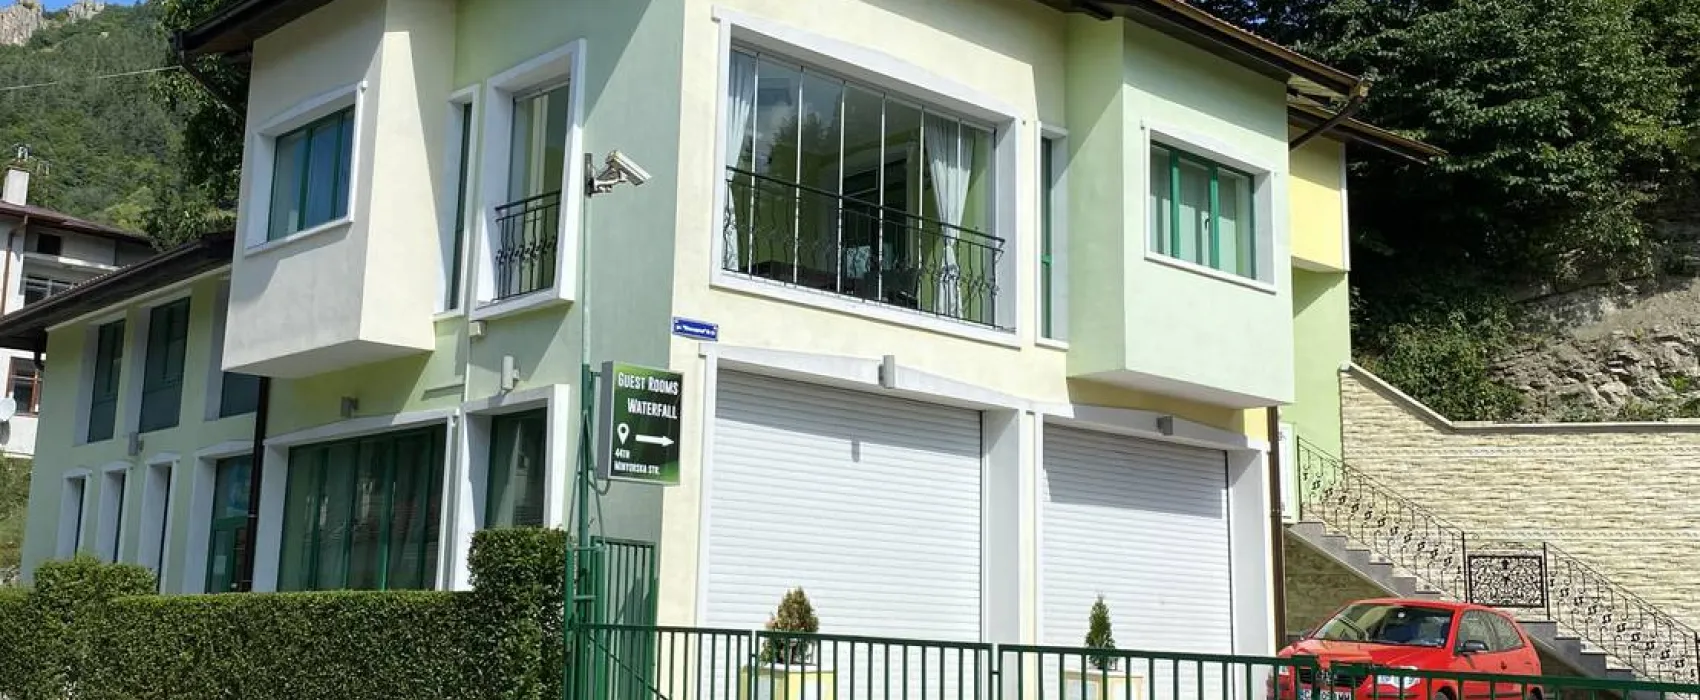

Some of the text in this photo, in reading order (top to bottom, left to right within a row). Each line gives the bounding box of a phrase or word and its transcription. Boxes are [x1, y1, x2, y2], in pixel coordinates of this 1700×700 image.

[618, 372, 678, 395] GUEST ROOMS
[627, 398, 678, 420] WATERFALL
